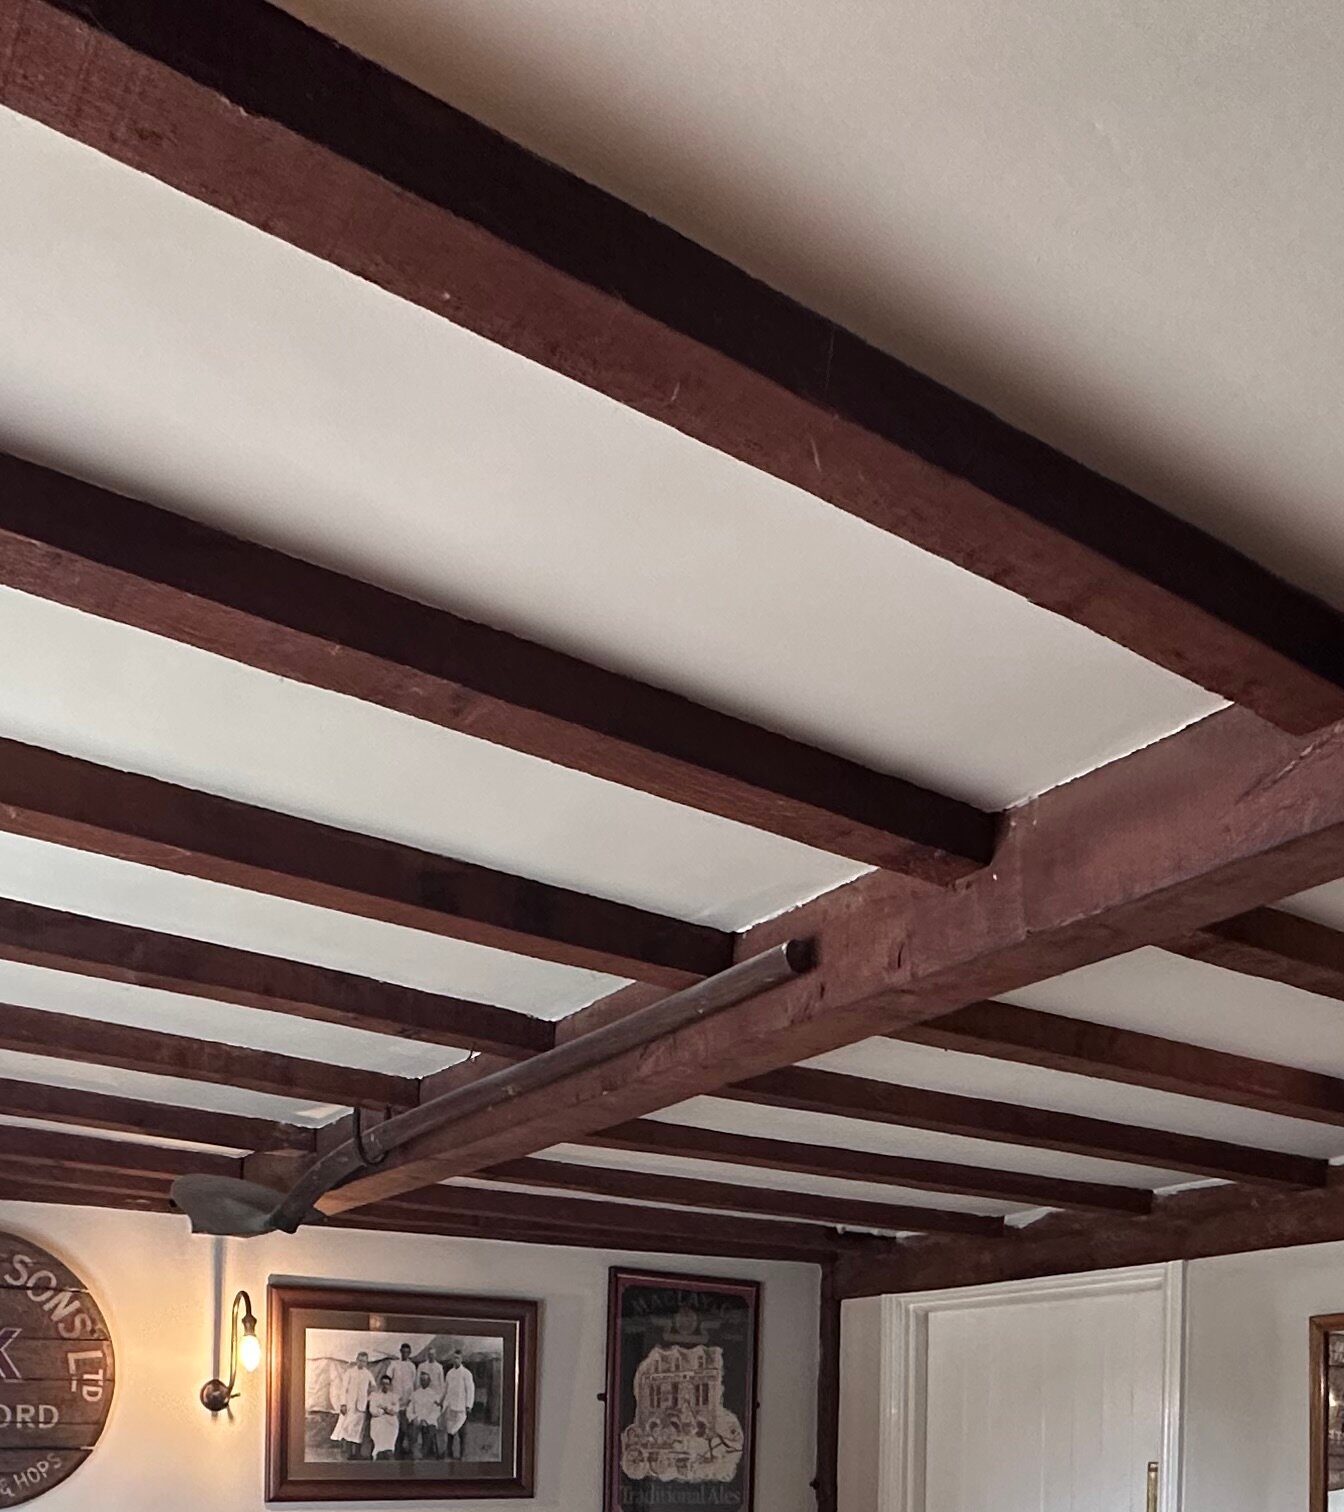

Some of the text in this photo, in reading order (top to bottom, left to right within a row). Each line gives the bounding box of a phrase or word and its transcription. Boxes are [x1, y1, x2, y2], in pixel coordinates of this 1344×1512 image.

[5, 1254, 93, 1340] SONS
[66, 1350, 104, 1402] LTD
[13, 1452, 64, 1490] HOPS
[620, 1481, 742, 1505] Traditional Ales
